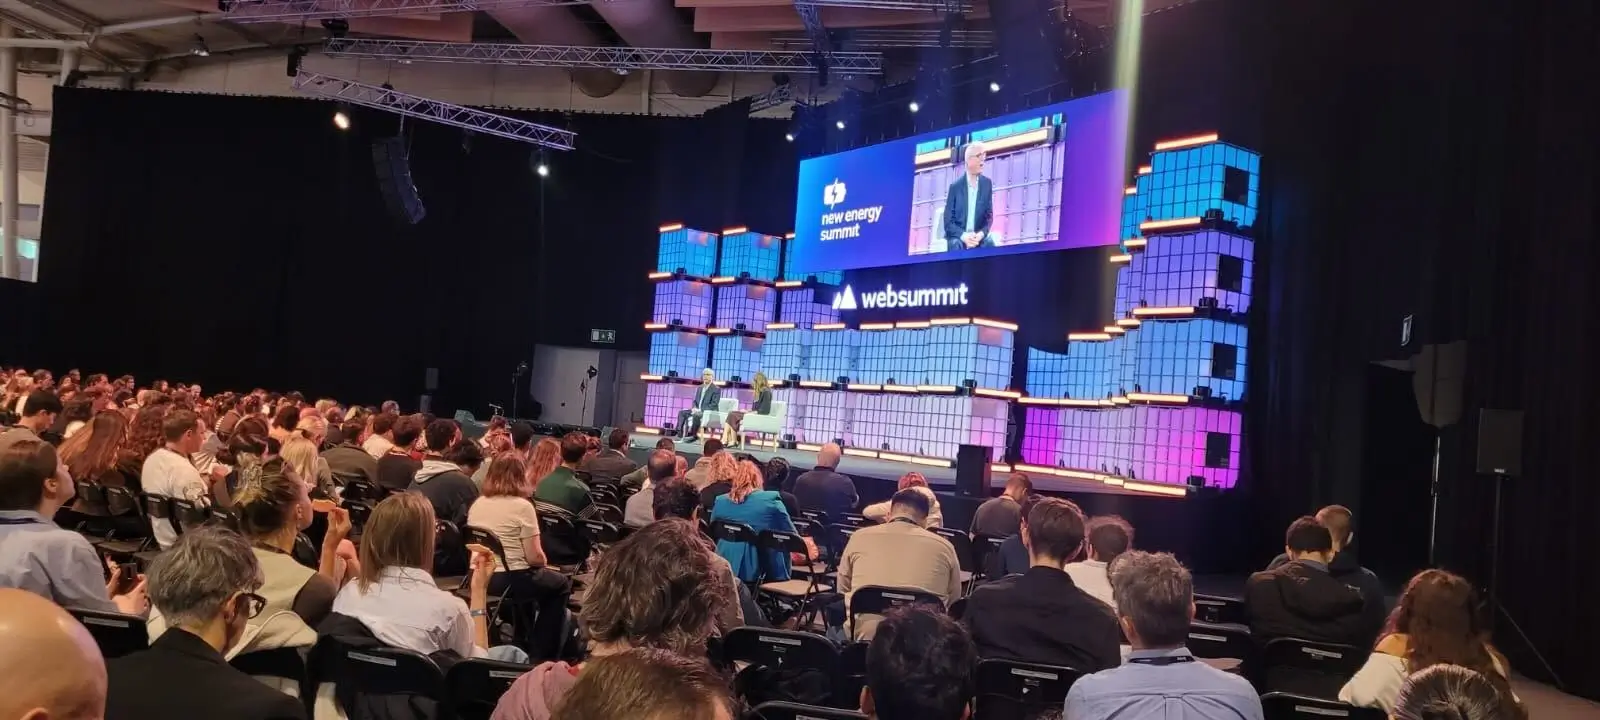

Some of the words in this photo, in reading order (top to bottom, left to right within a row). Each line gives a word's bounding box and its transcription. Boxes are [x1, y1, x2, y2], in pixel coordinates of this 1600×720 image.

[821, 212, 844, 226] new
[844, 205, 883, 223] energy
[820, 222, 860, 241] summit
[861, 283, 969, 309] websummit
